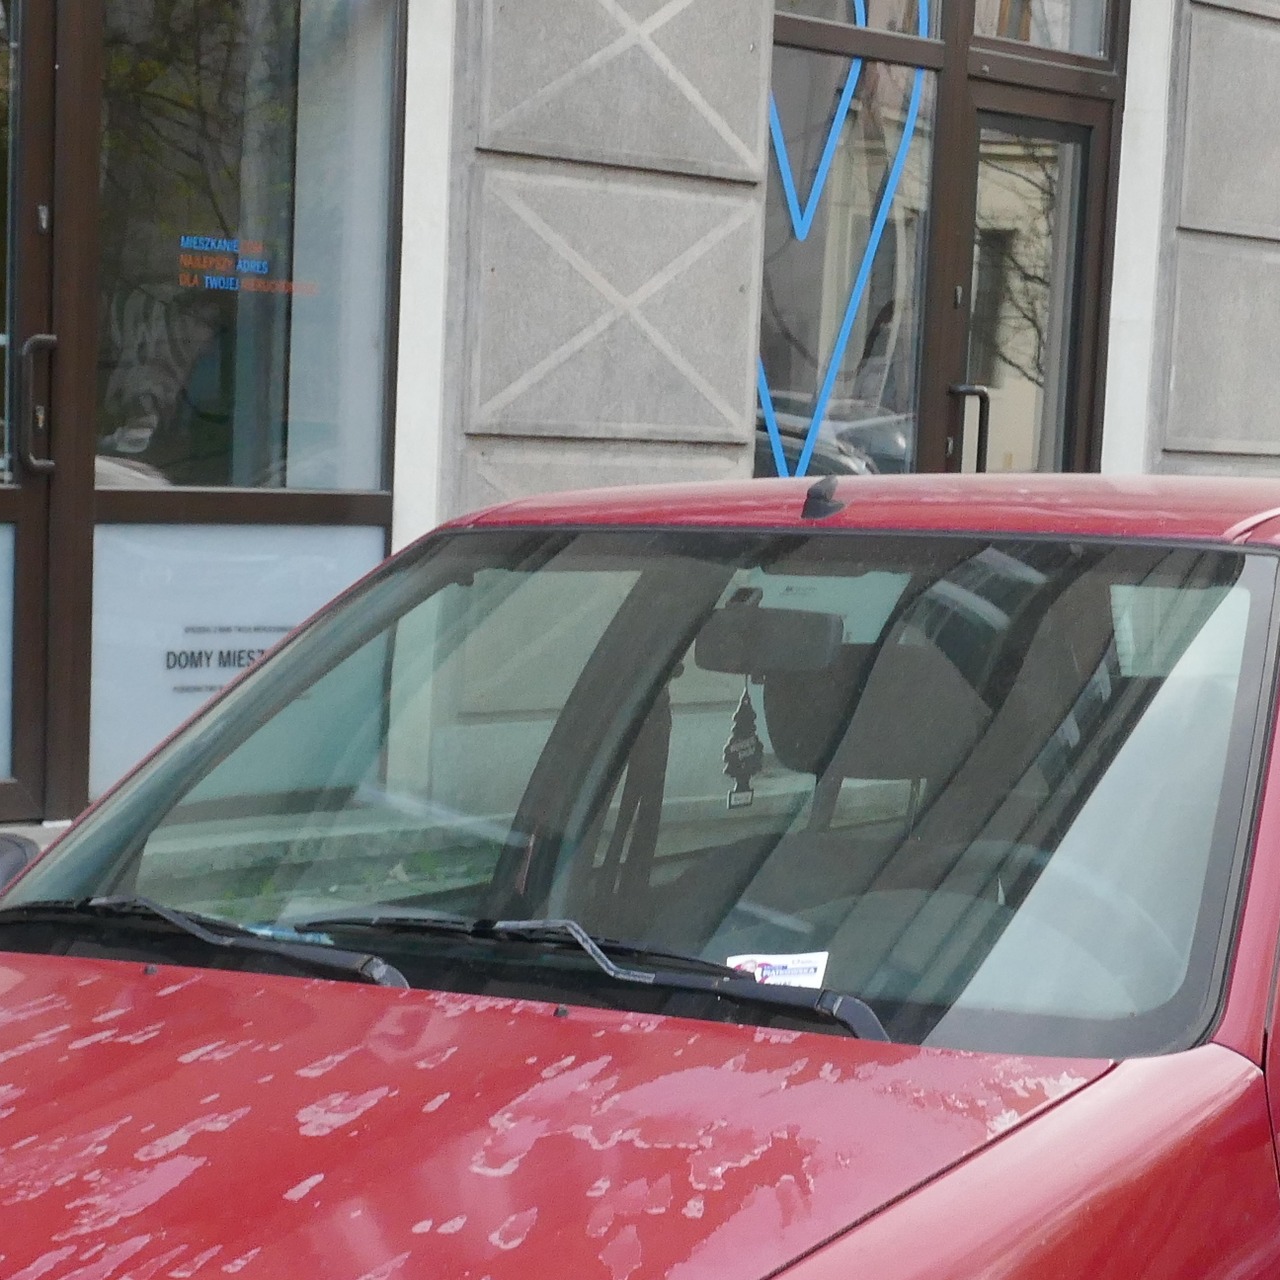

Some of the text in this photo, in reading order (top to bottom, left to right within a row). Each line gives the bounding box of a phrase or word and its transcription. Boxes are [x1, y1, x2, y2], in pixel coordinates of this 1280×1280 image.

[236, 259, 269, 275] ADRES
[179, 272, 200, 287] DLA
[204, 275, 241, 291] TWOJEJ
[166, 650, 214, 669] DOMY
